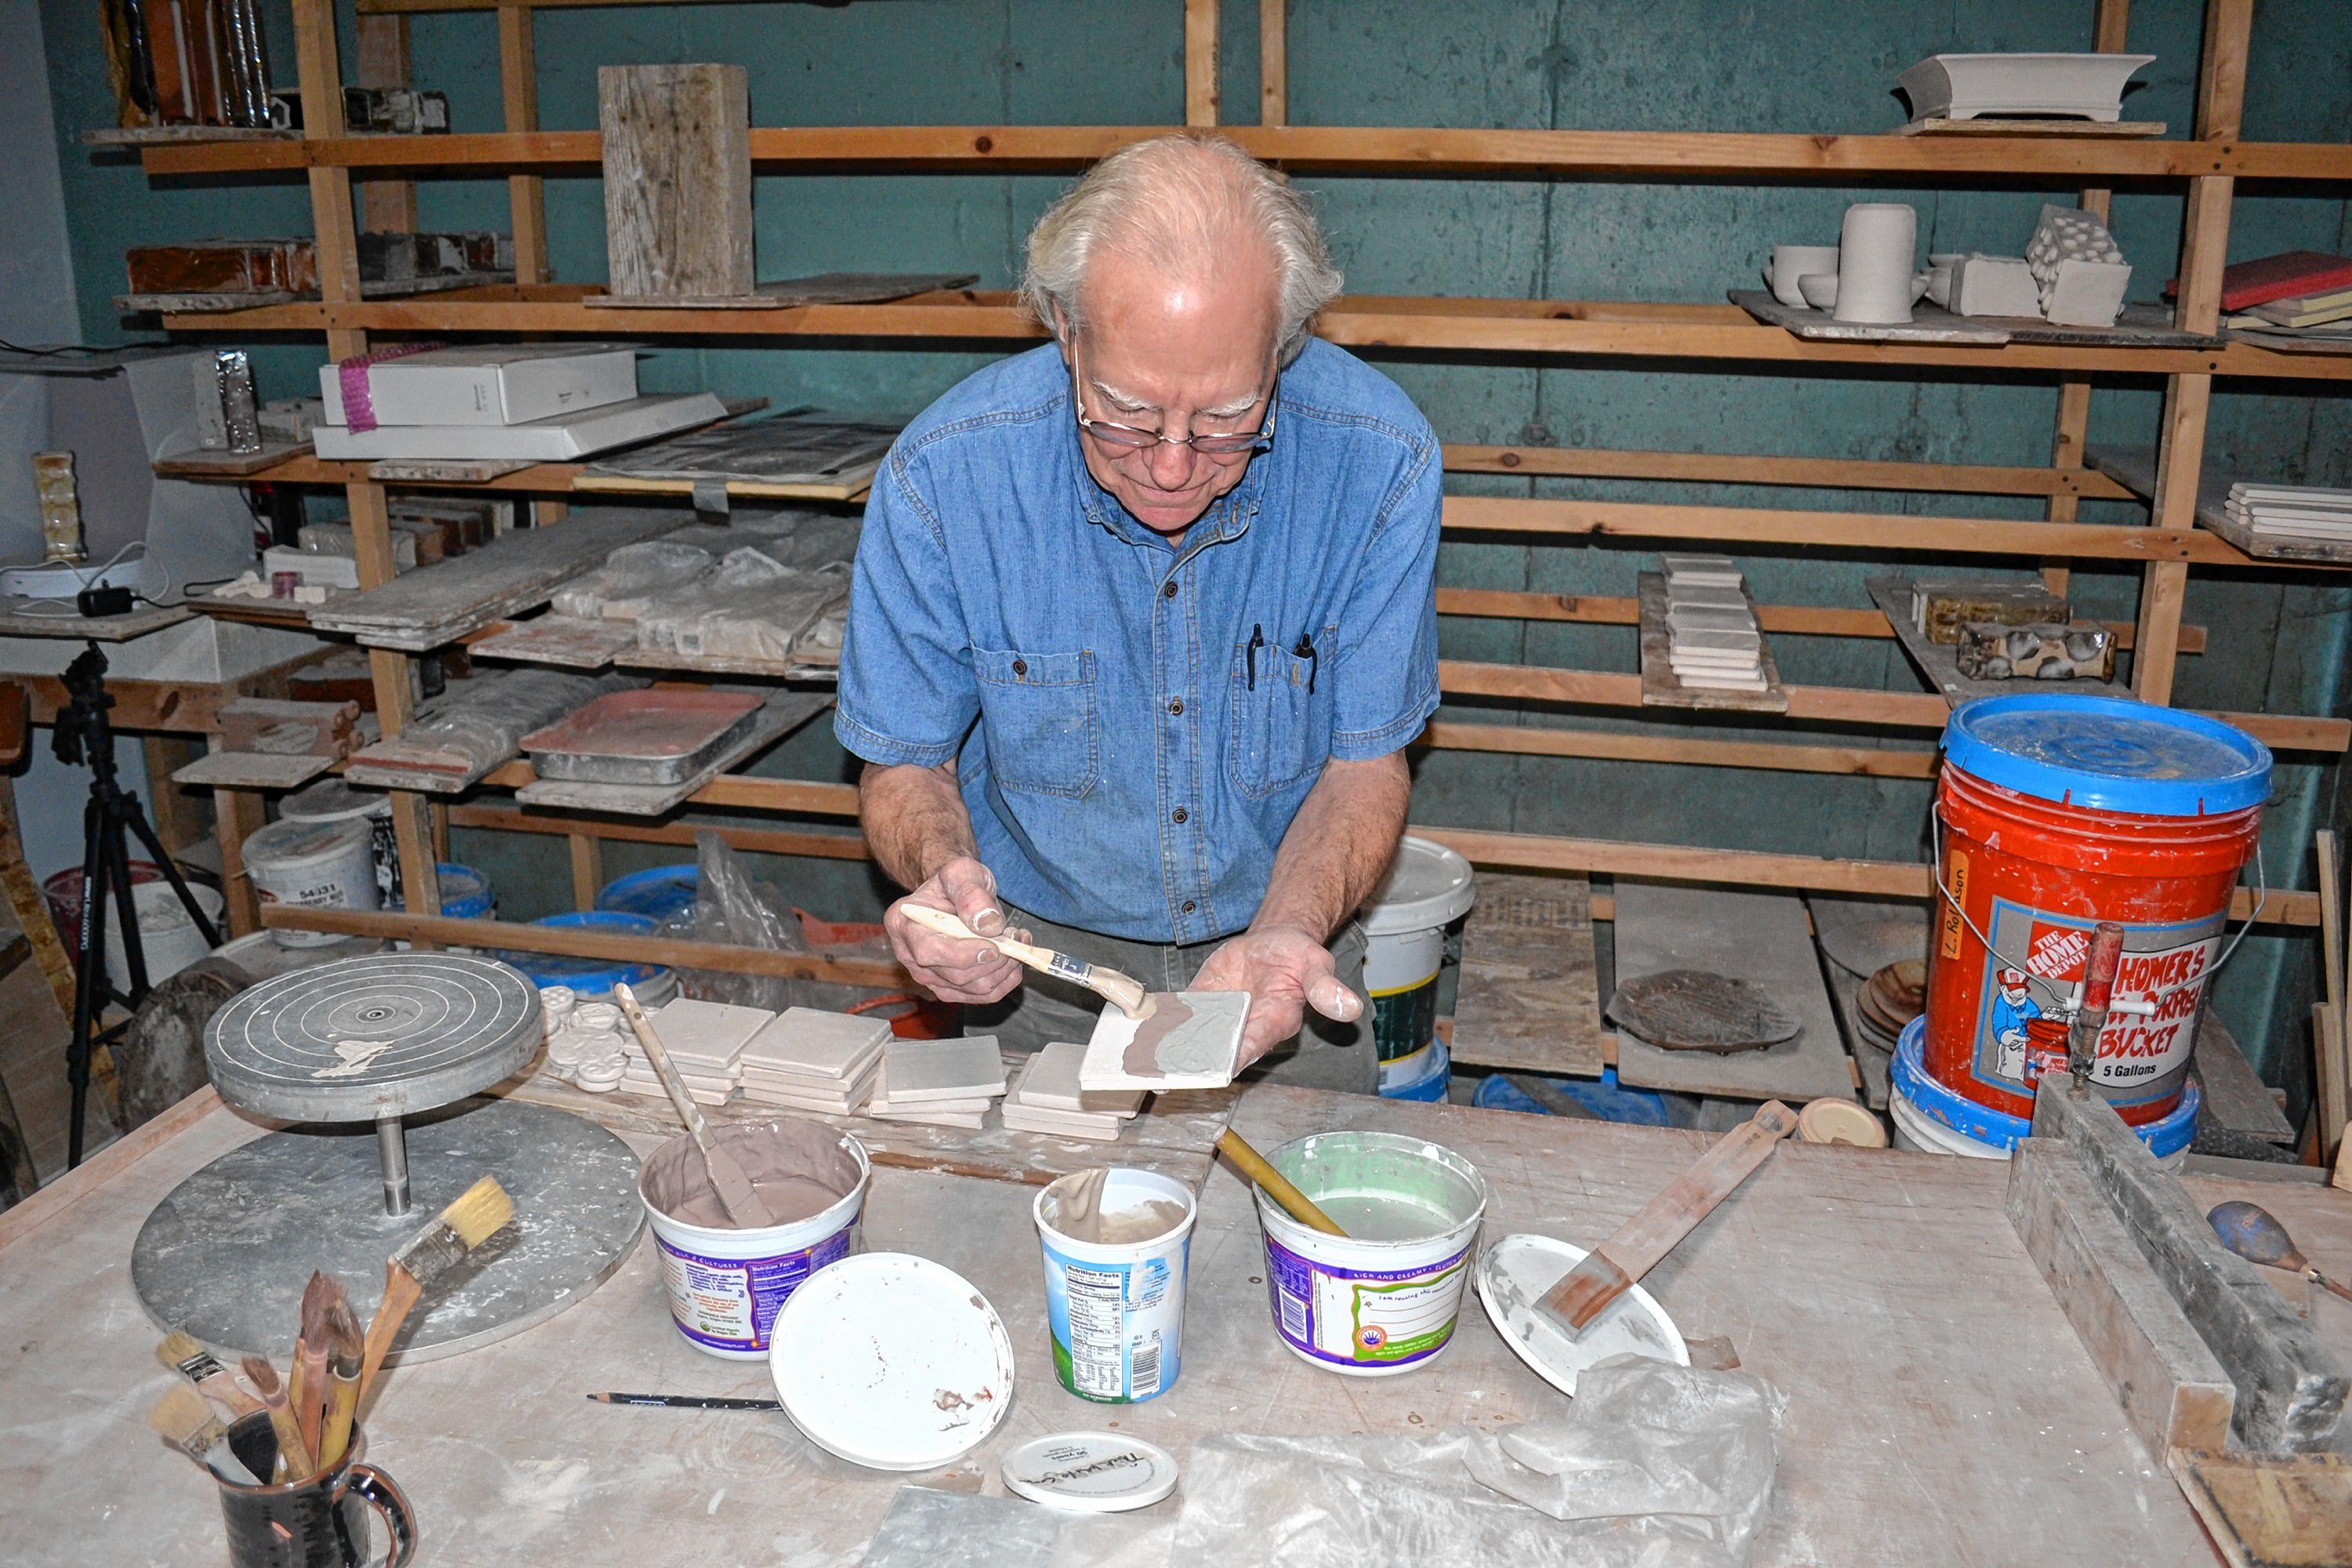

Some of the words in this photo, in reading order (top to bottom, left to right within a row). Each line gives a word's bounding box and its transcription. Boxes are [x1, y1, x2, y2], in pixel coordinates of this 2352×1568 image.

[1945, 938, 1958, 954] L.
[2034, 930, 2063, 951] THE
[2027, 931, 2090, 975] HOME
[2046, 949, 2086, 979] DEPOT
[2096, 1022, 2180, 1059] BUCKET
[2103, 1065, 2112, 1077] 5
[2114, 1064, 2157, 1077] Gallons
[699, 1258, 738, 1269] CULTURES
[1067, 1264, 1097, 1277] Nutrition
[1397, 1268, 1427, 1280] CREAMY
[1435, 1258, 1457, 1271] GLUTEN
[1395, 1292, 1418, 1301] reusing
